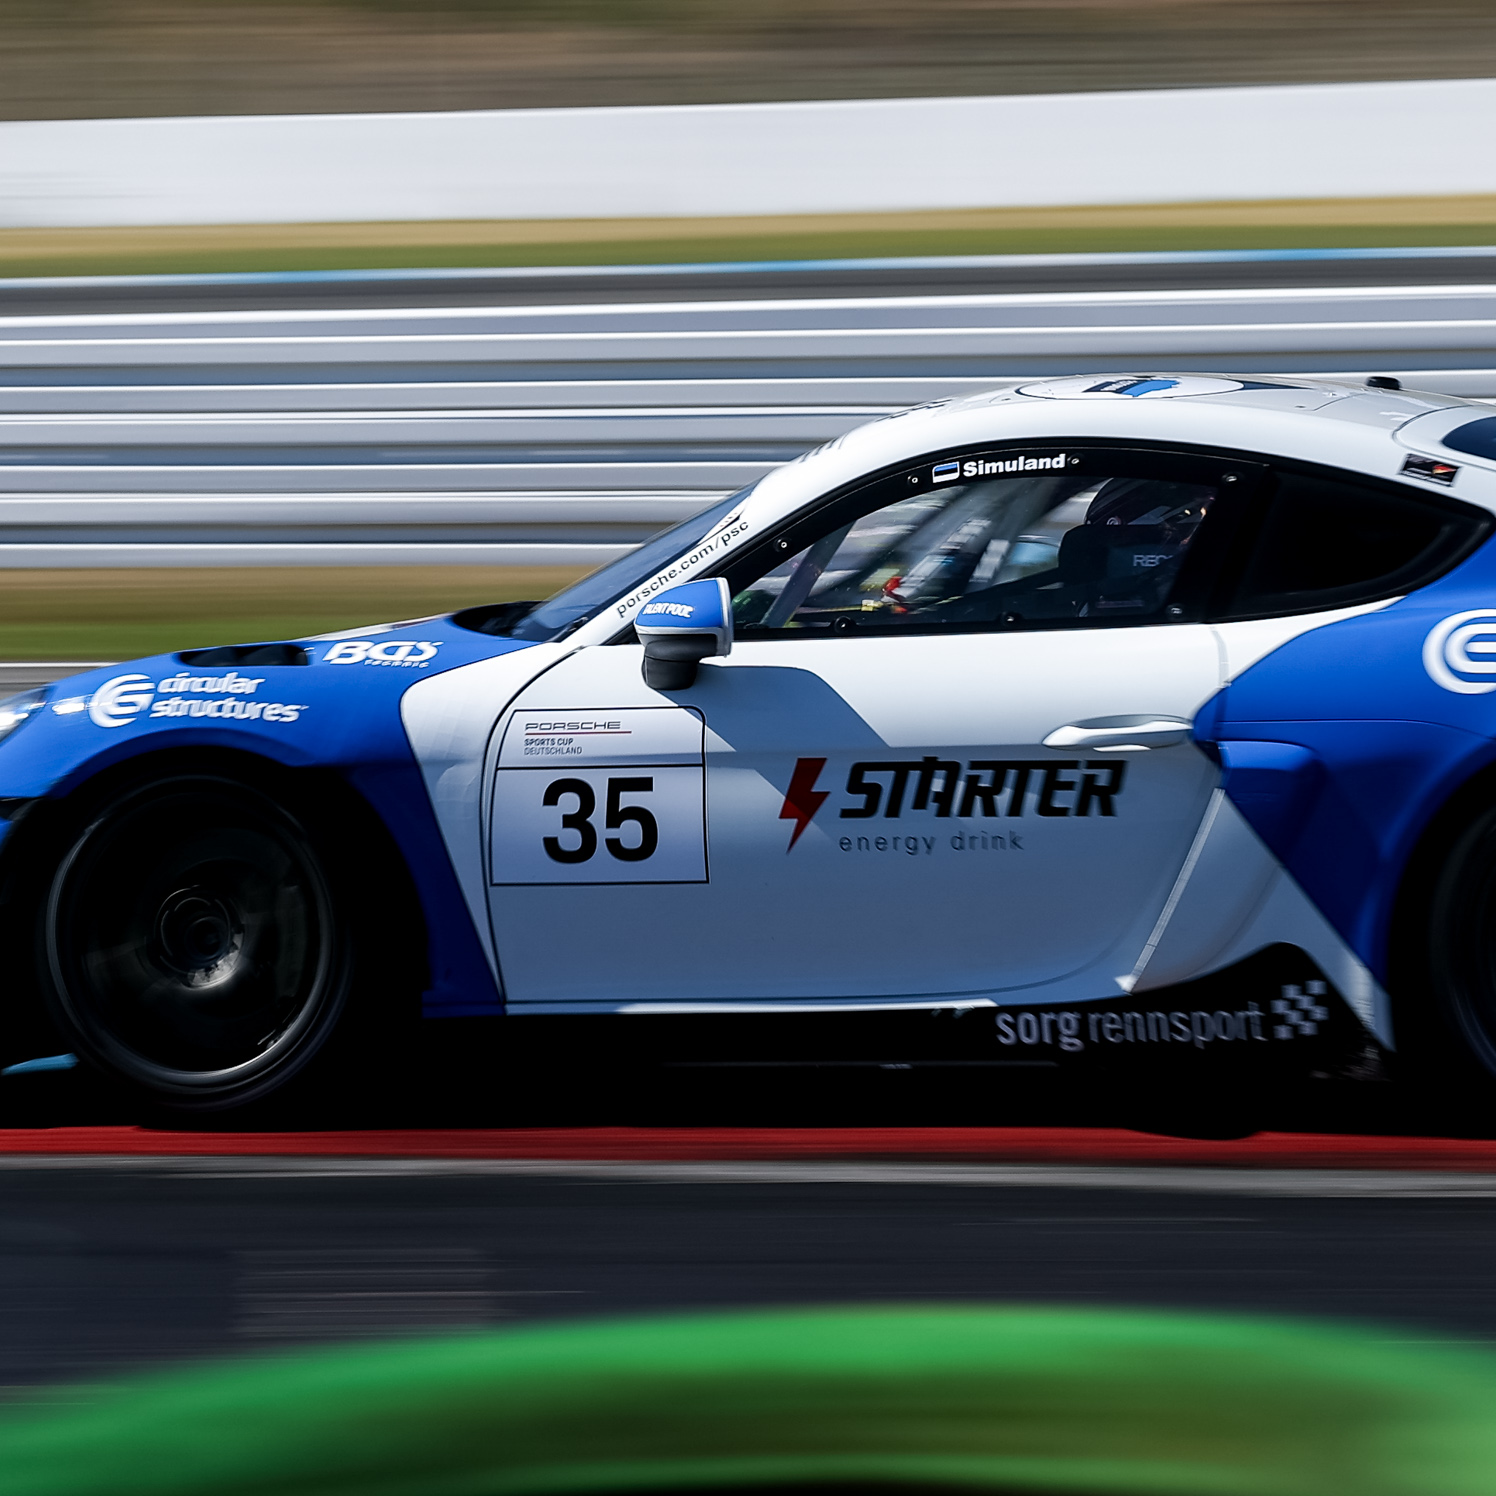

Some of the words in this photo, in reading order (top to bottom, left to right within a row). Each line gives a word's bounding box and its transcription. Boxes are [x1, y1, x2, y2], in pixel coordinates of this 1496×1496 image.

[962, 453, 1066, 478] Simuland
[616, 521, 750, 618] porsche.com/psc
[155, 671, 265, 695] circular
[148, 696, 303, 724] structures
[525, 721, 622, 731] PORSCHE
[524, 737, 556, 746] SPORTS
[557, 737, 574, 746] CUP
[524, 746, 583, 755] DEUTSCHLAND
[839, 756, 1128, 819] STARTER
[542, 776, 658, 864] 35
[839, 834, 937, 855] energy
[950, 830, 1024, 851] drink
[995, 1011, 1085, 1052] sorg
[1088, 1000, 1269, 1050] rennsport
